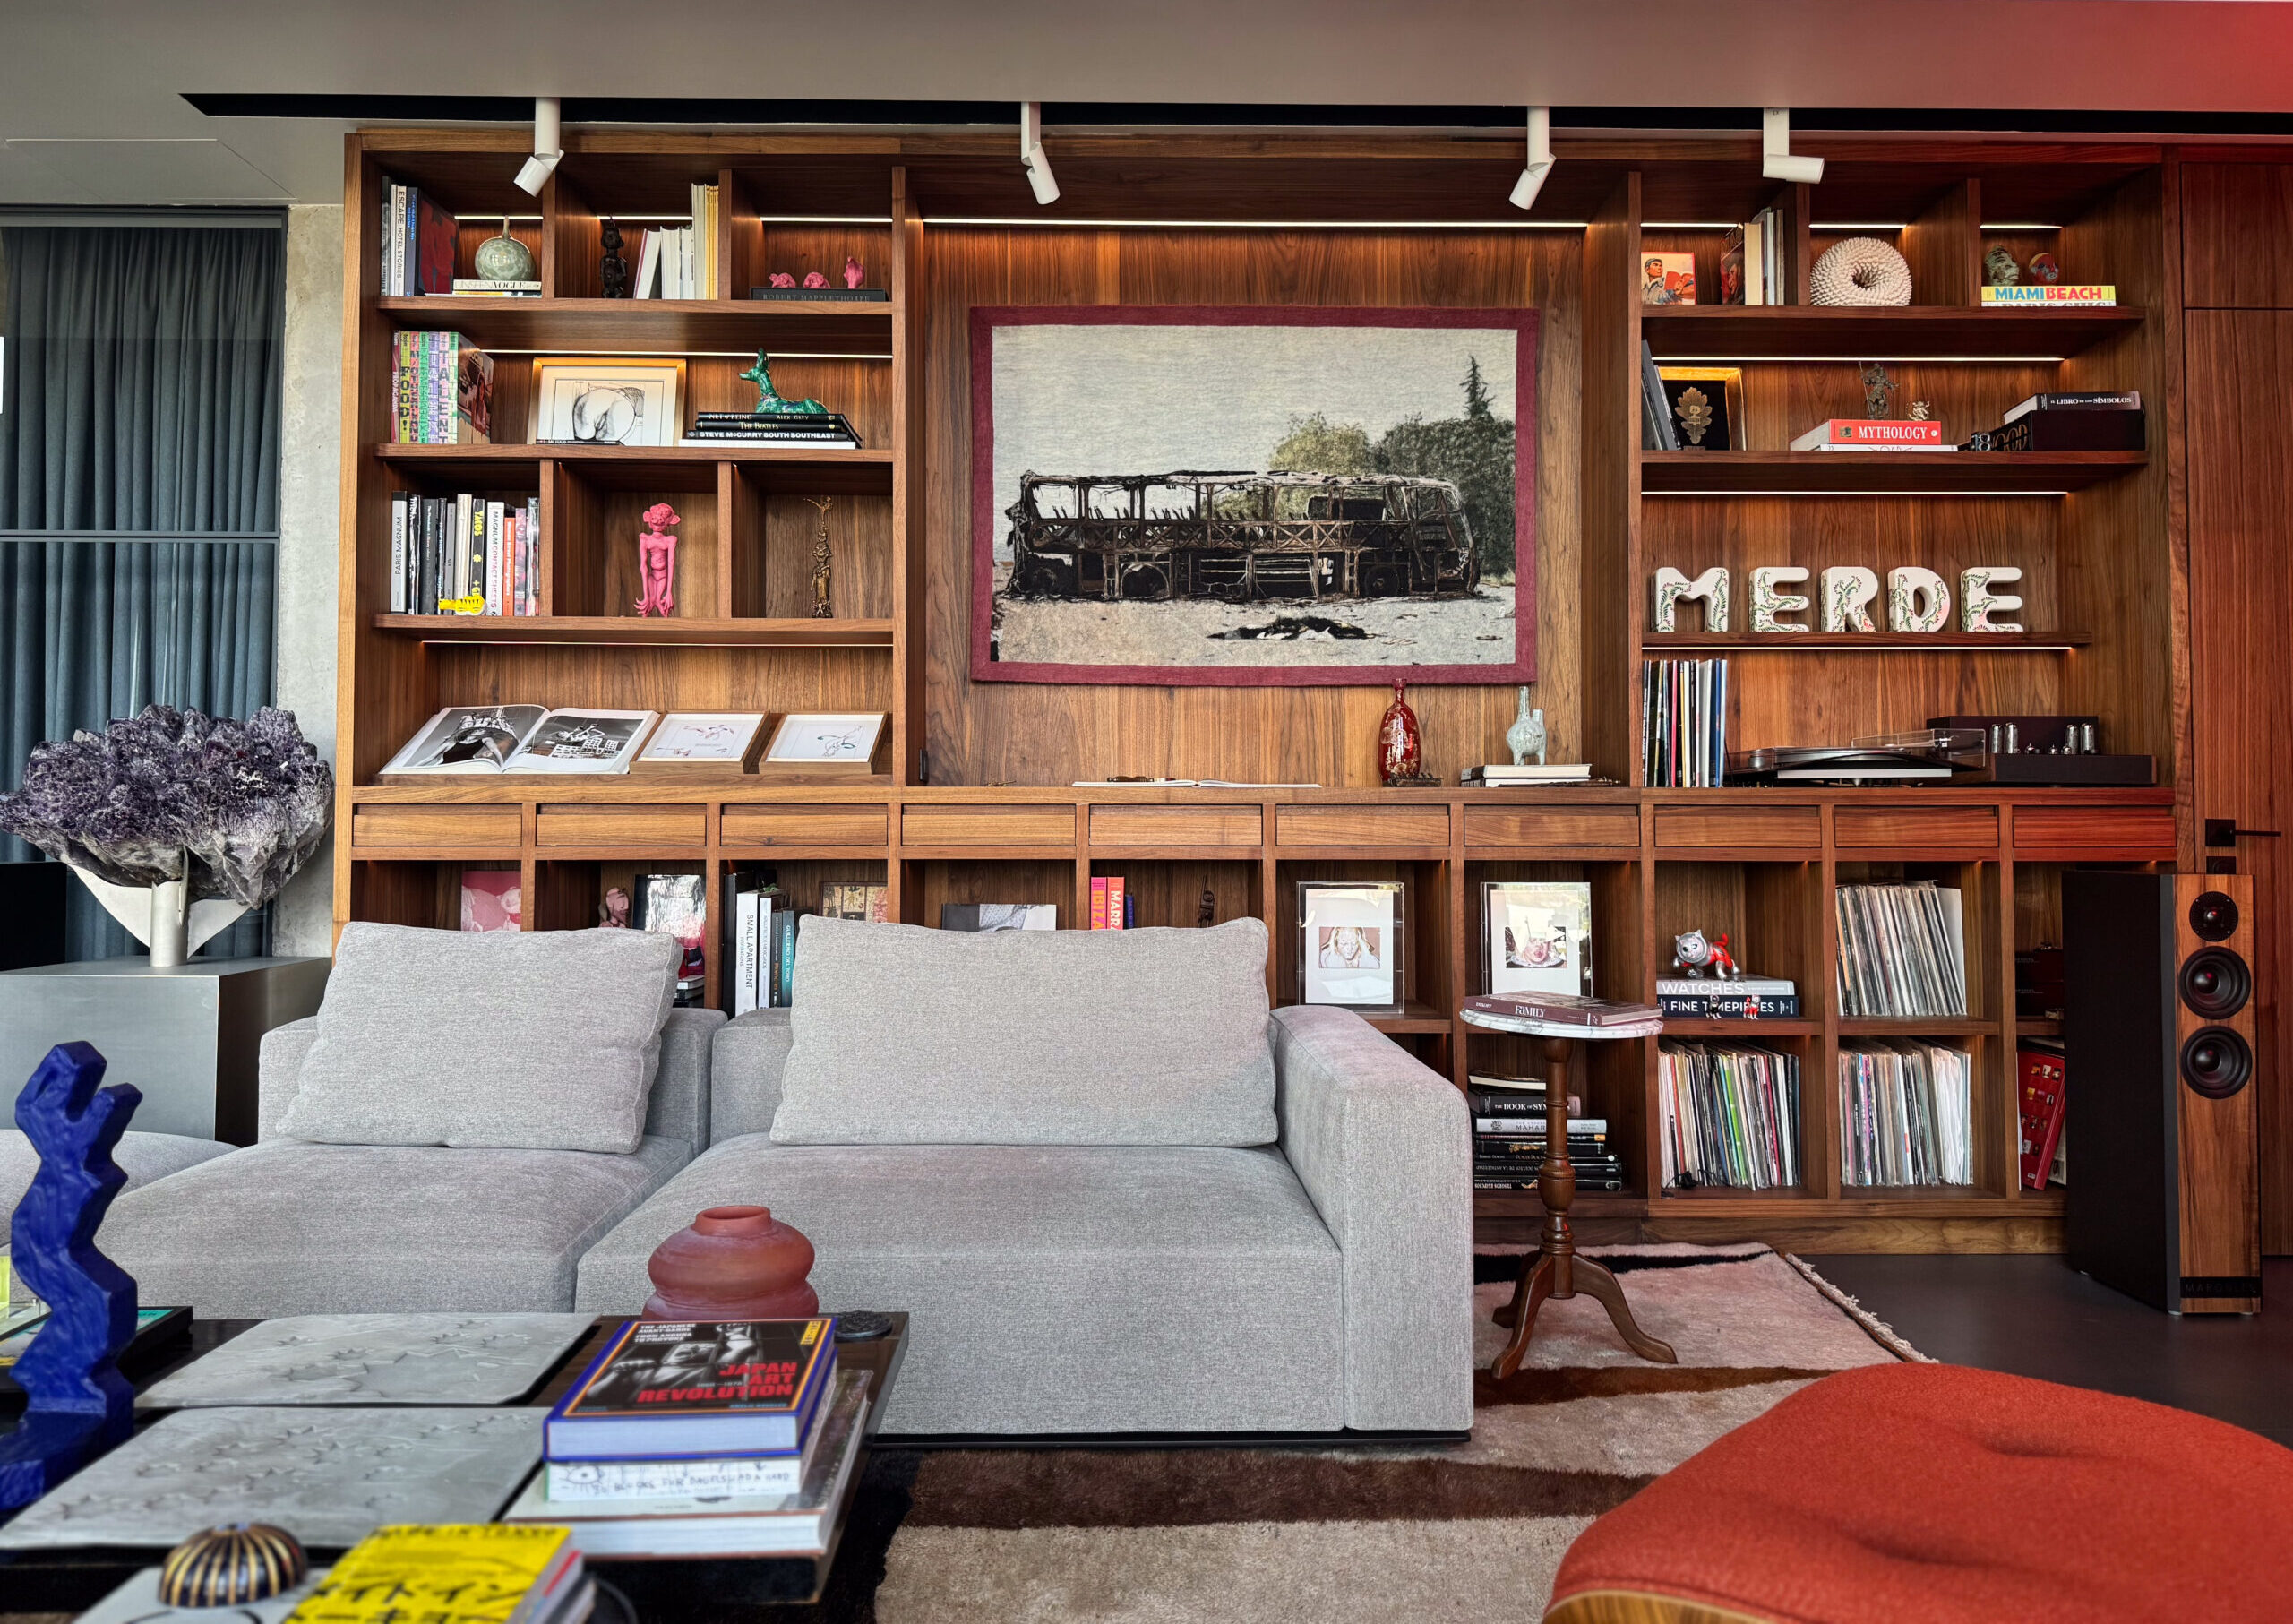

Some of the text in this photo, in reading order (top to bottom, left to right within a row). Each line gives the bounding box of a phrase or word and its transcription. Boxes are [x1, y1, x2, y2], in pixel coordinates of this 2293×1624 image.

[391, 371, 399, 413] PROPAGANDA
[1859, 425, 1928, 440] MYTHOLOGY
[394, 517, 402, 553] MAGNUM
[1652, 566, 2024, 632] MERDE
[1093, 889, 1104, 930] IBIZA
[1110, 890, 1121, 930] MARR
[745, 942, 753, 989] APARTMENT
[1661, 982, 1745, 995] WATCHES
[1670, 1001, 1698, 1012] FINE
[718, 1362, 798, 1376] JAPAN
[748, 1373, 795, 1385] ART
[637, 1384, 794, 1403] REVOLUTION
